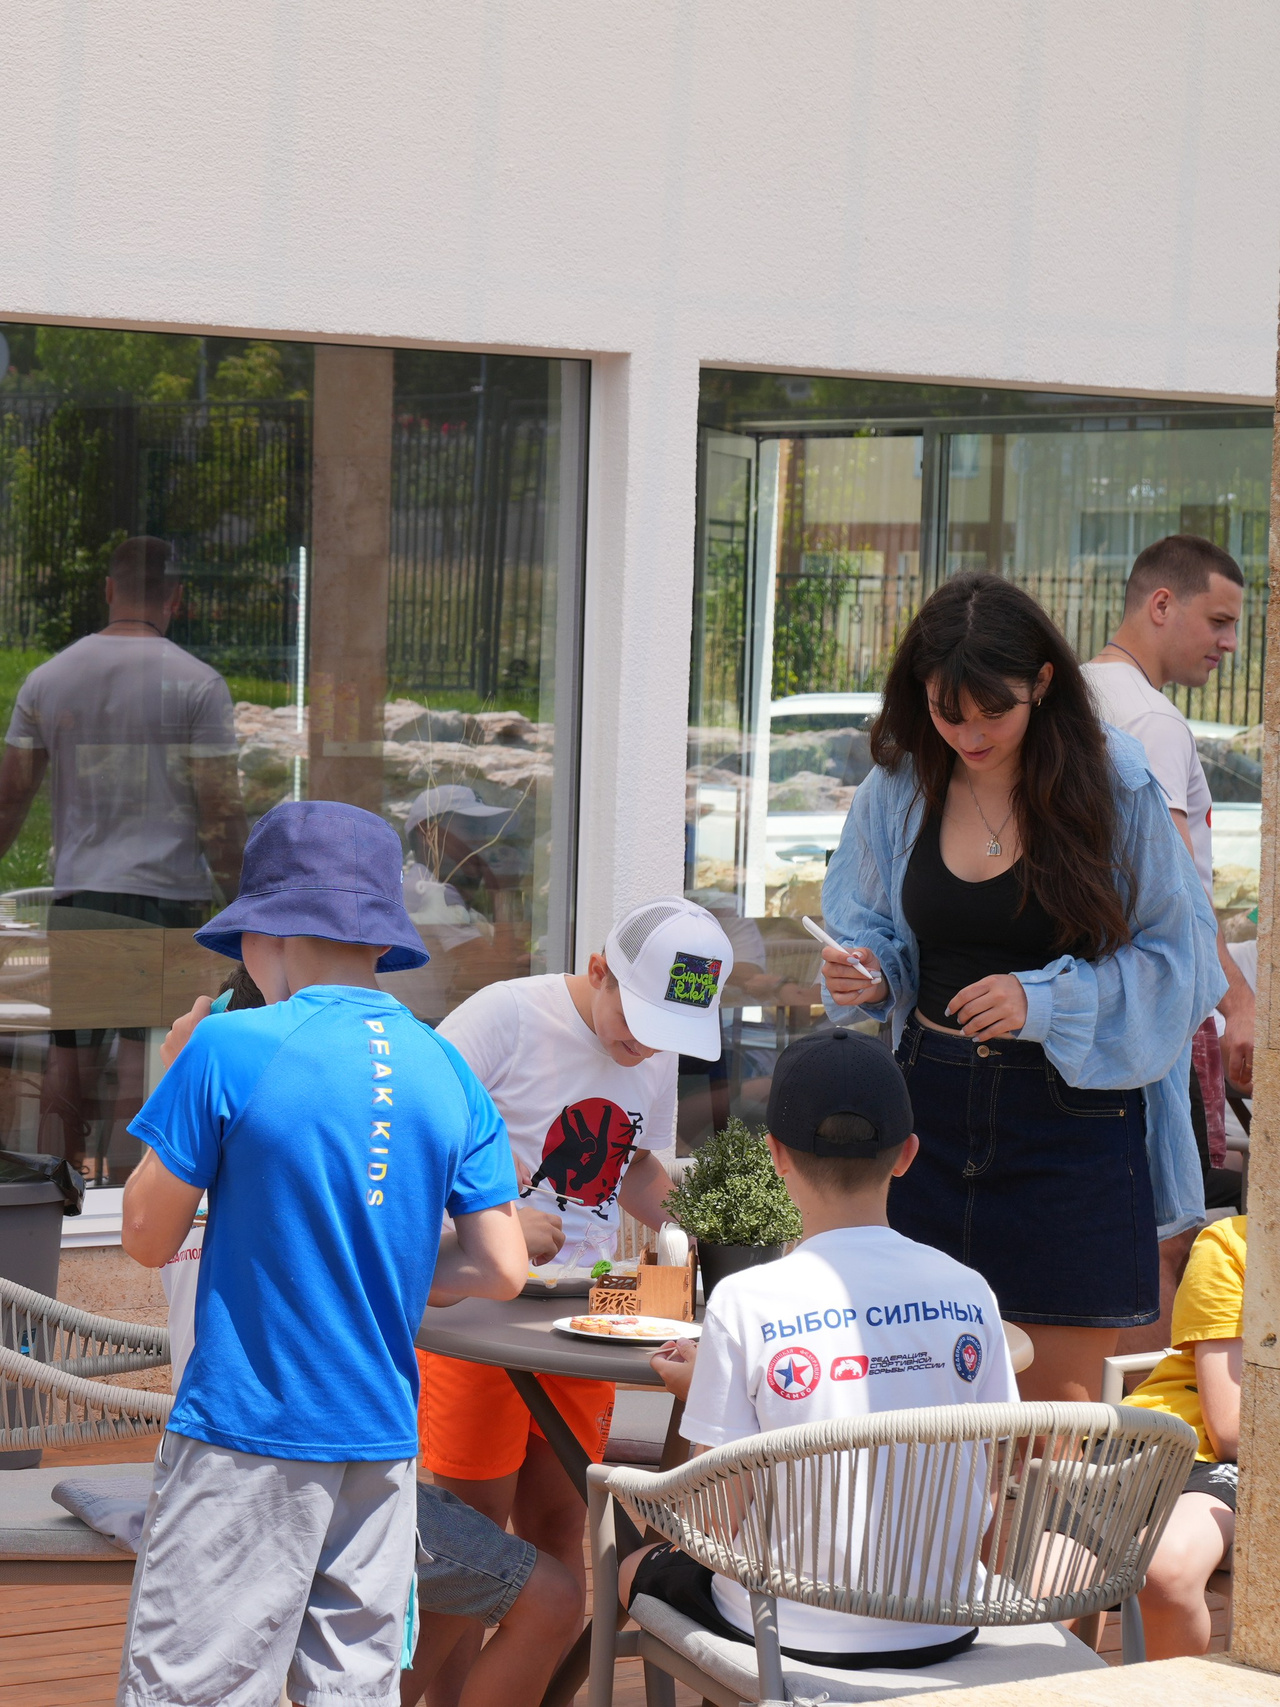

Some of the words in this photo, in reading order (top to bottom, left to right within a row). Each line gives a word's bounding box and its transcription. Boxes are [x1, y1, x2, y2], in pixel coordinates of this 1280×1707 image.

[363, 1020, 393, 1106] PEAK
[366, 1121, 391, 1206] KIDS
[761, 1308, 857, 1344] ВЫБОР
[866, 1300, 985, 1327] СИЛЬНЫХ
[869, 1356, 933, 1369] СПОРТИВНОЙ
[870, 1351, 928, 1363] ФЕДЕРАЦИЯ
[868, 1366, 906, 1376] БОРЬБЫ
[906, 1362, 945, 1372] РОССИИ
[780, 1387, 812, 1399] САМБО
